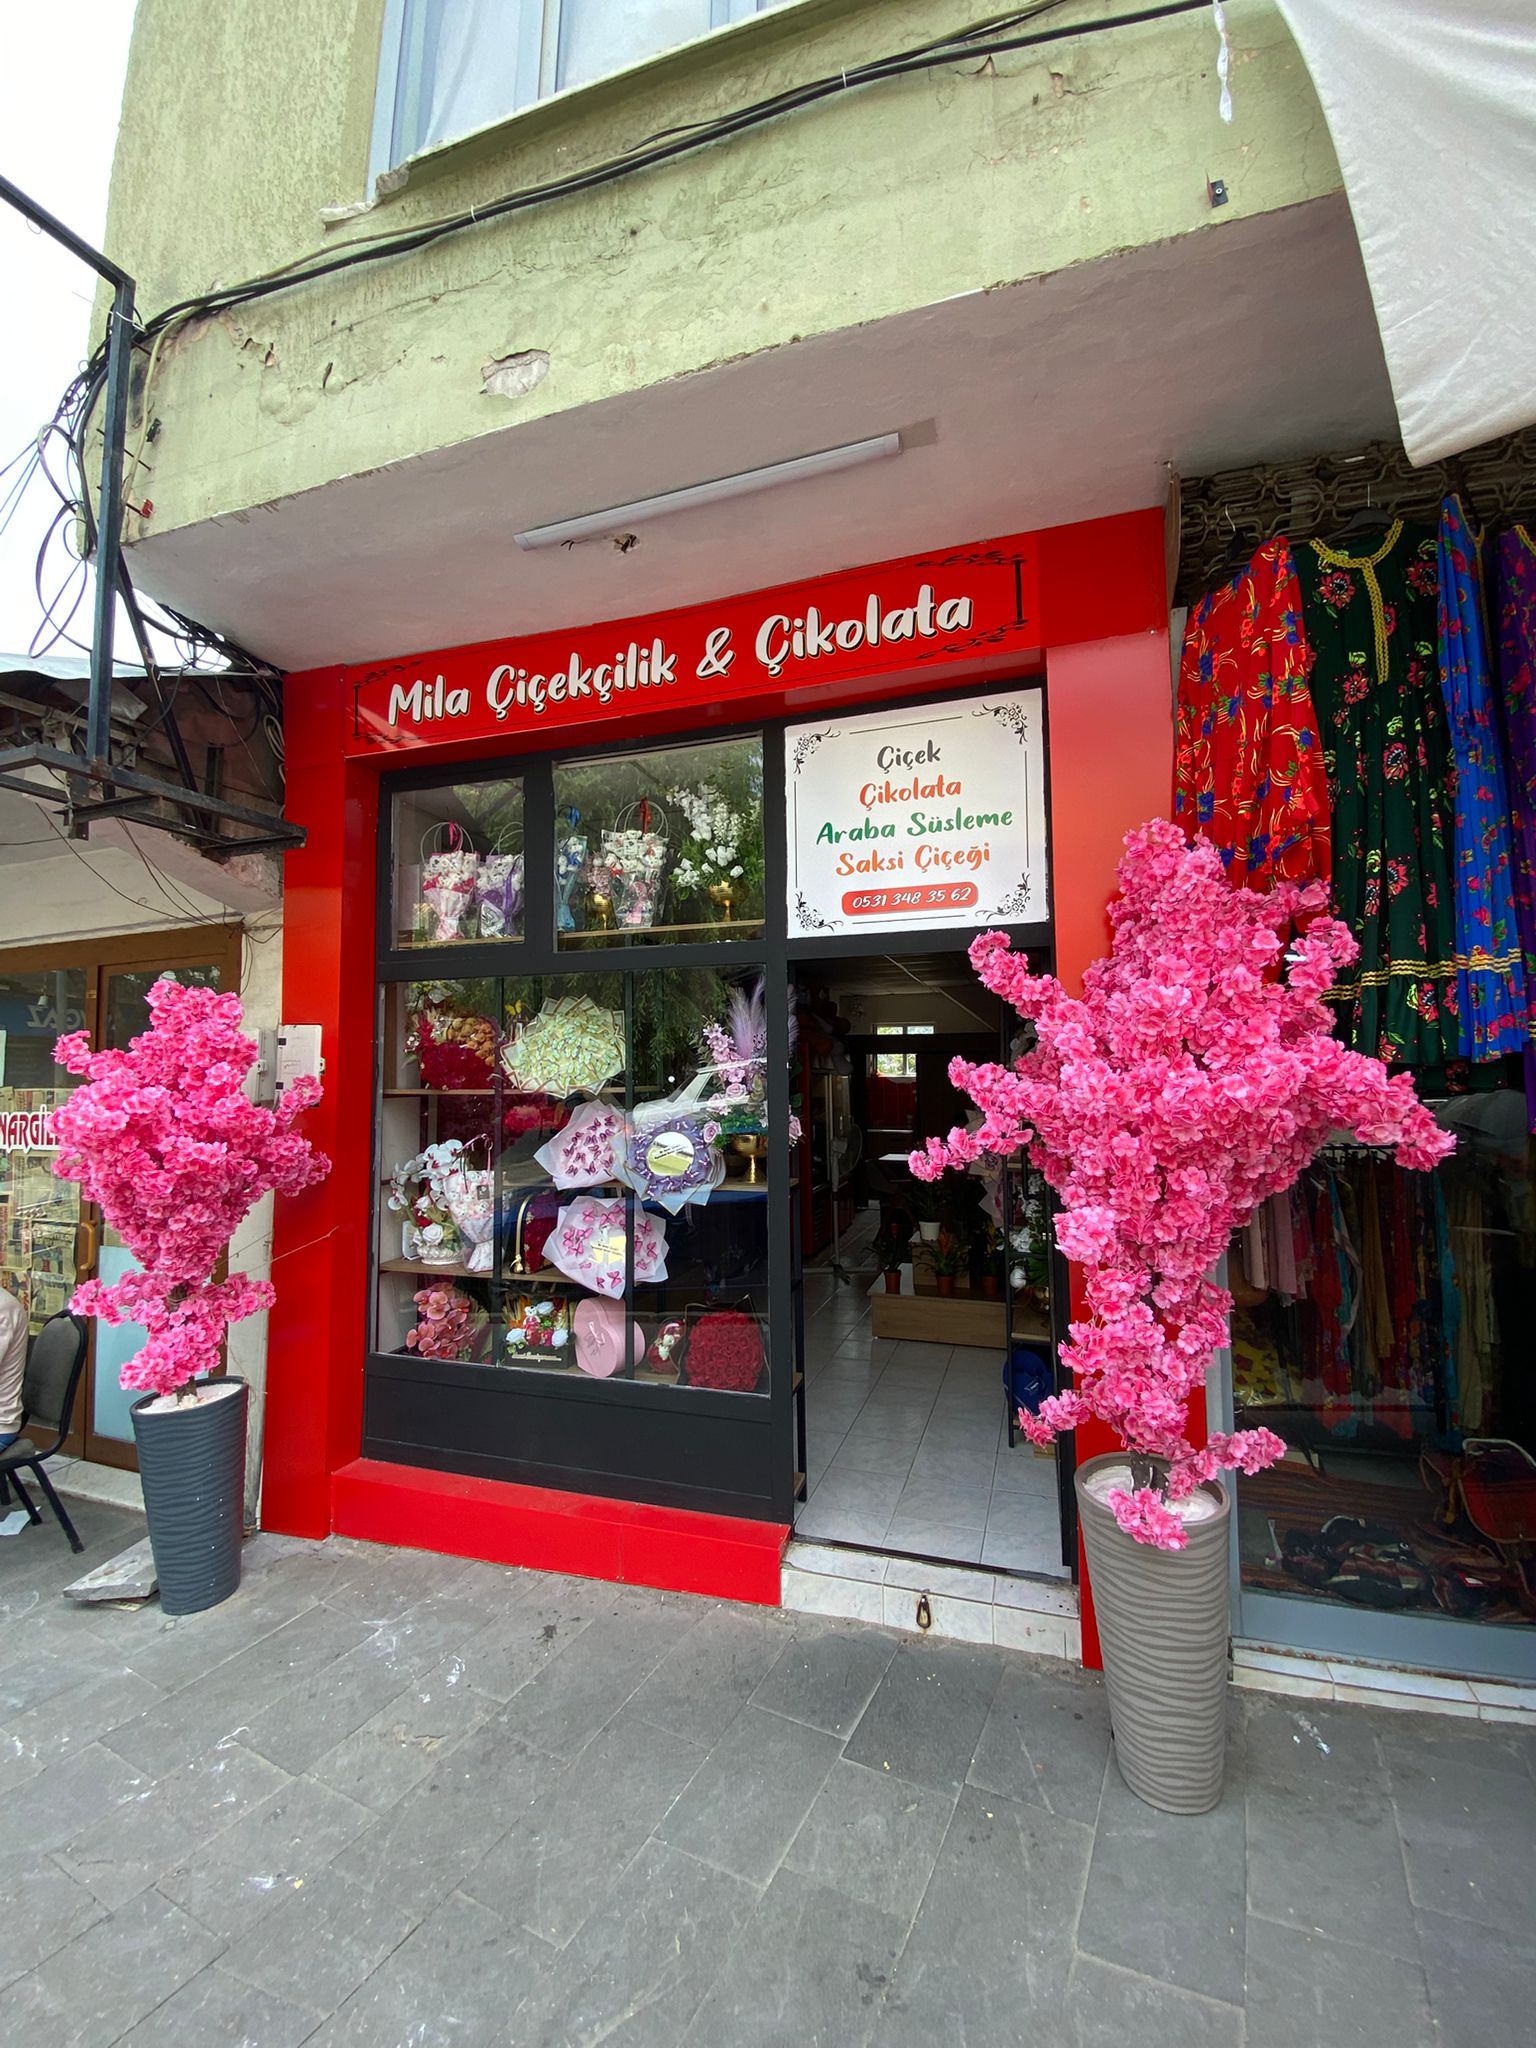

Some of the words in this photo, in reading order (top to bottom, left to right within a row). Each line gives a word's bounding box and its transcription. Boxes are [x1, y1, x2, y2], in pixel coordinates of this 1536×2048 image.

[388, 673, 470, 727] Mila
[485, 636, 678, 720] Çiçekçilik
[695, 627, 735, 680] &
[755, 584, 974, 676] Çikolata
[876, 739, 941, 774] Çiçek
[859, 774, 962, 812] Çikolata
[815, 817, 896, 846] Araba
[906, 807, 1014, 837] Süsleme
[835, 849, 904, 876] Saksi
[914, 842, 991, 874] Çiçeği
[851, 894, 888, 909] 0531
[892, 891, 922, 907] 348
[926, 889, 947, 904] 35
[950, 887, 972, 901] 62
[0, 1105, 60, 1148] NARGİL
